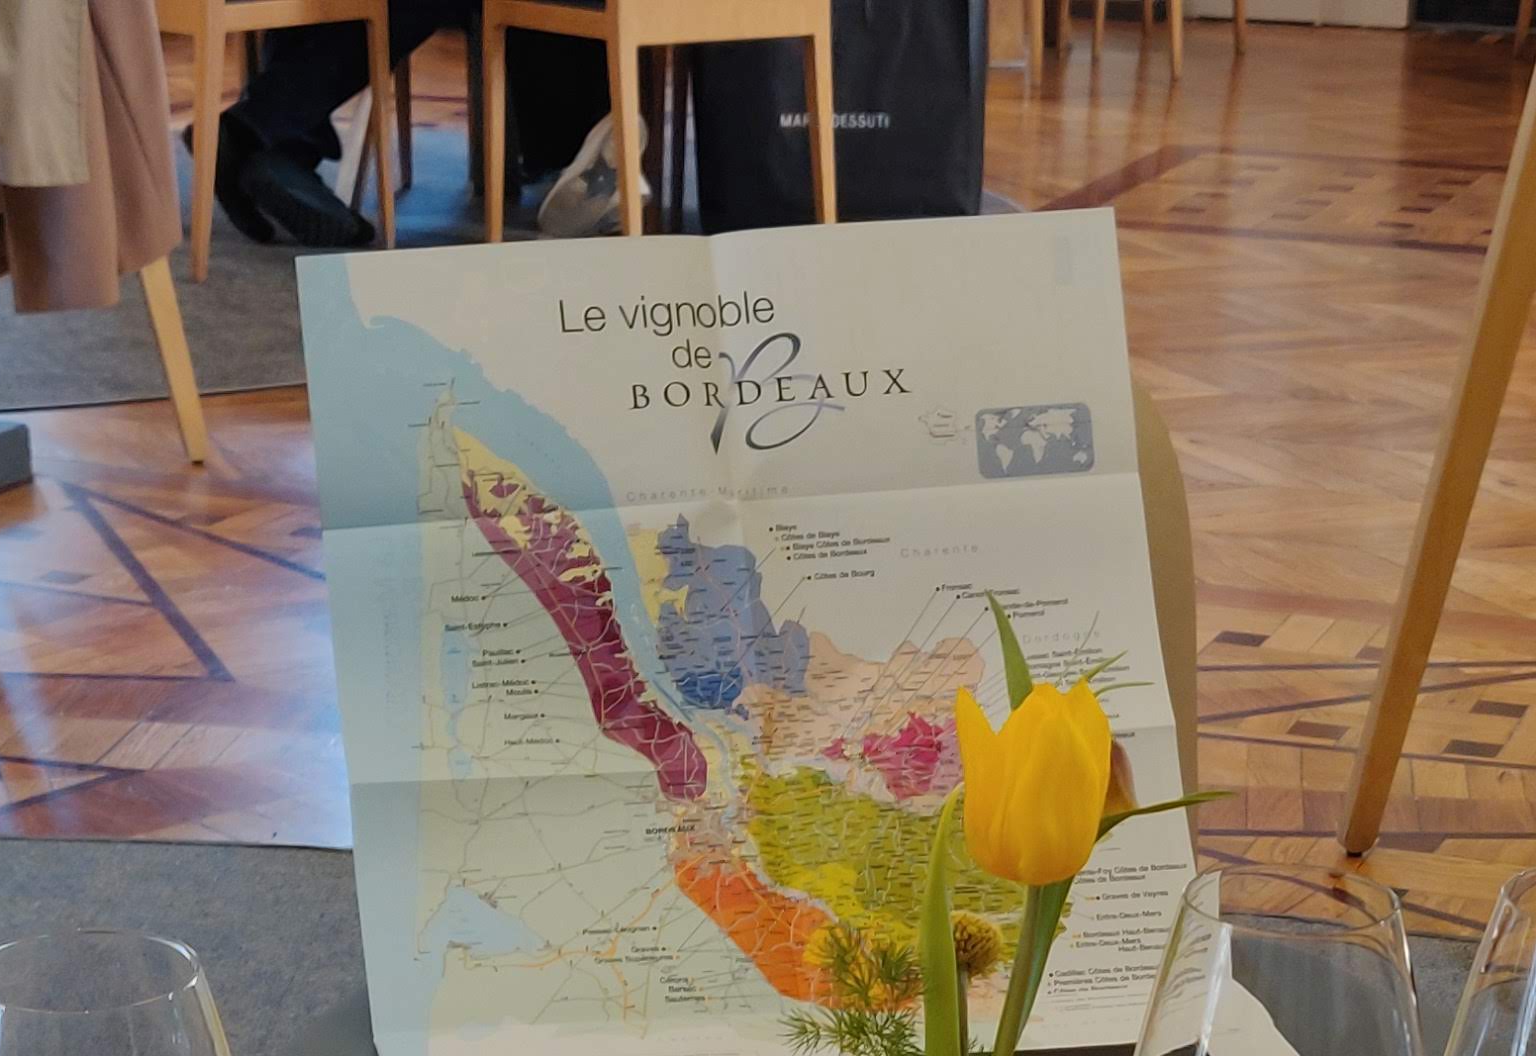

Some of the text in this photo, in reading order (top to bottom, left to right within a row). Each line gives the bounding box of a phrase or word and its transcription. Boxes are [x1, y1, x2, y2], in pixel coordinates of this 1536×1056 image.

[558, 290, 775, 337] Le vignoble
[671, 338, 713, 369] de
[629, 367, 912, 410] BORDEAUX
